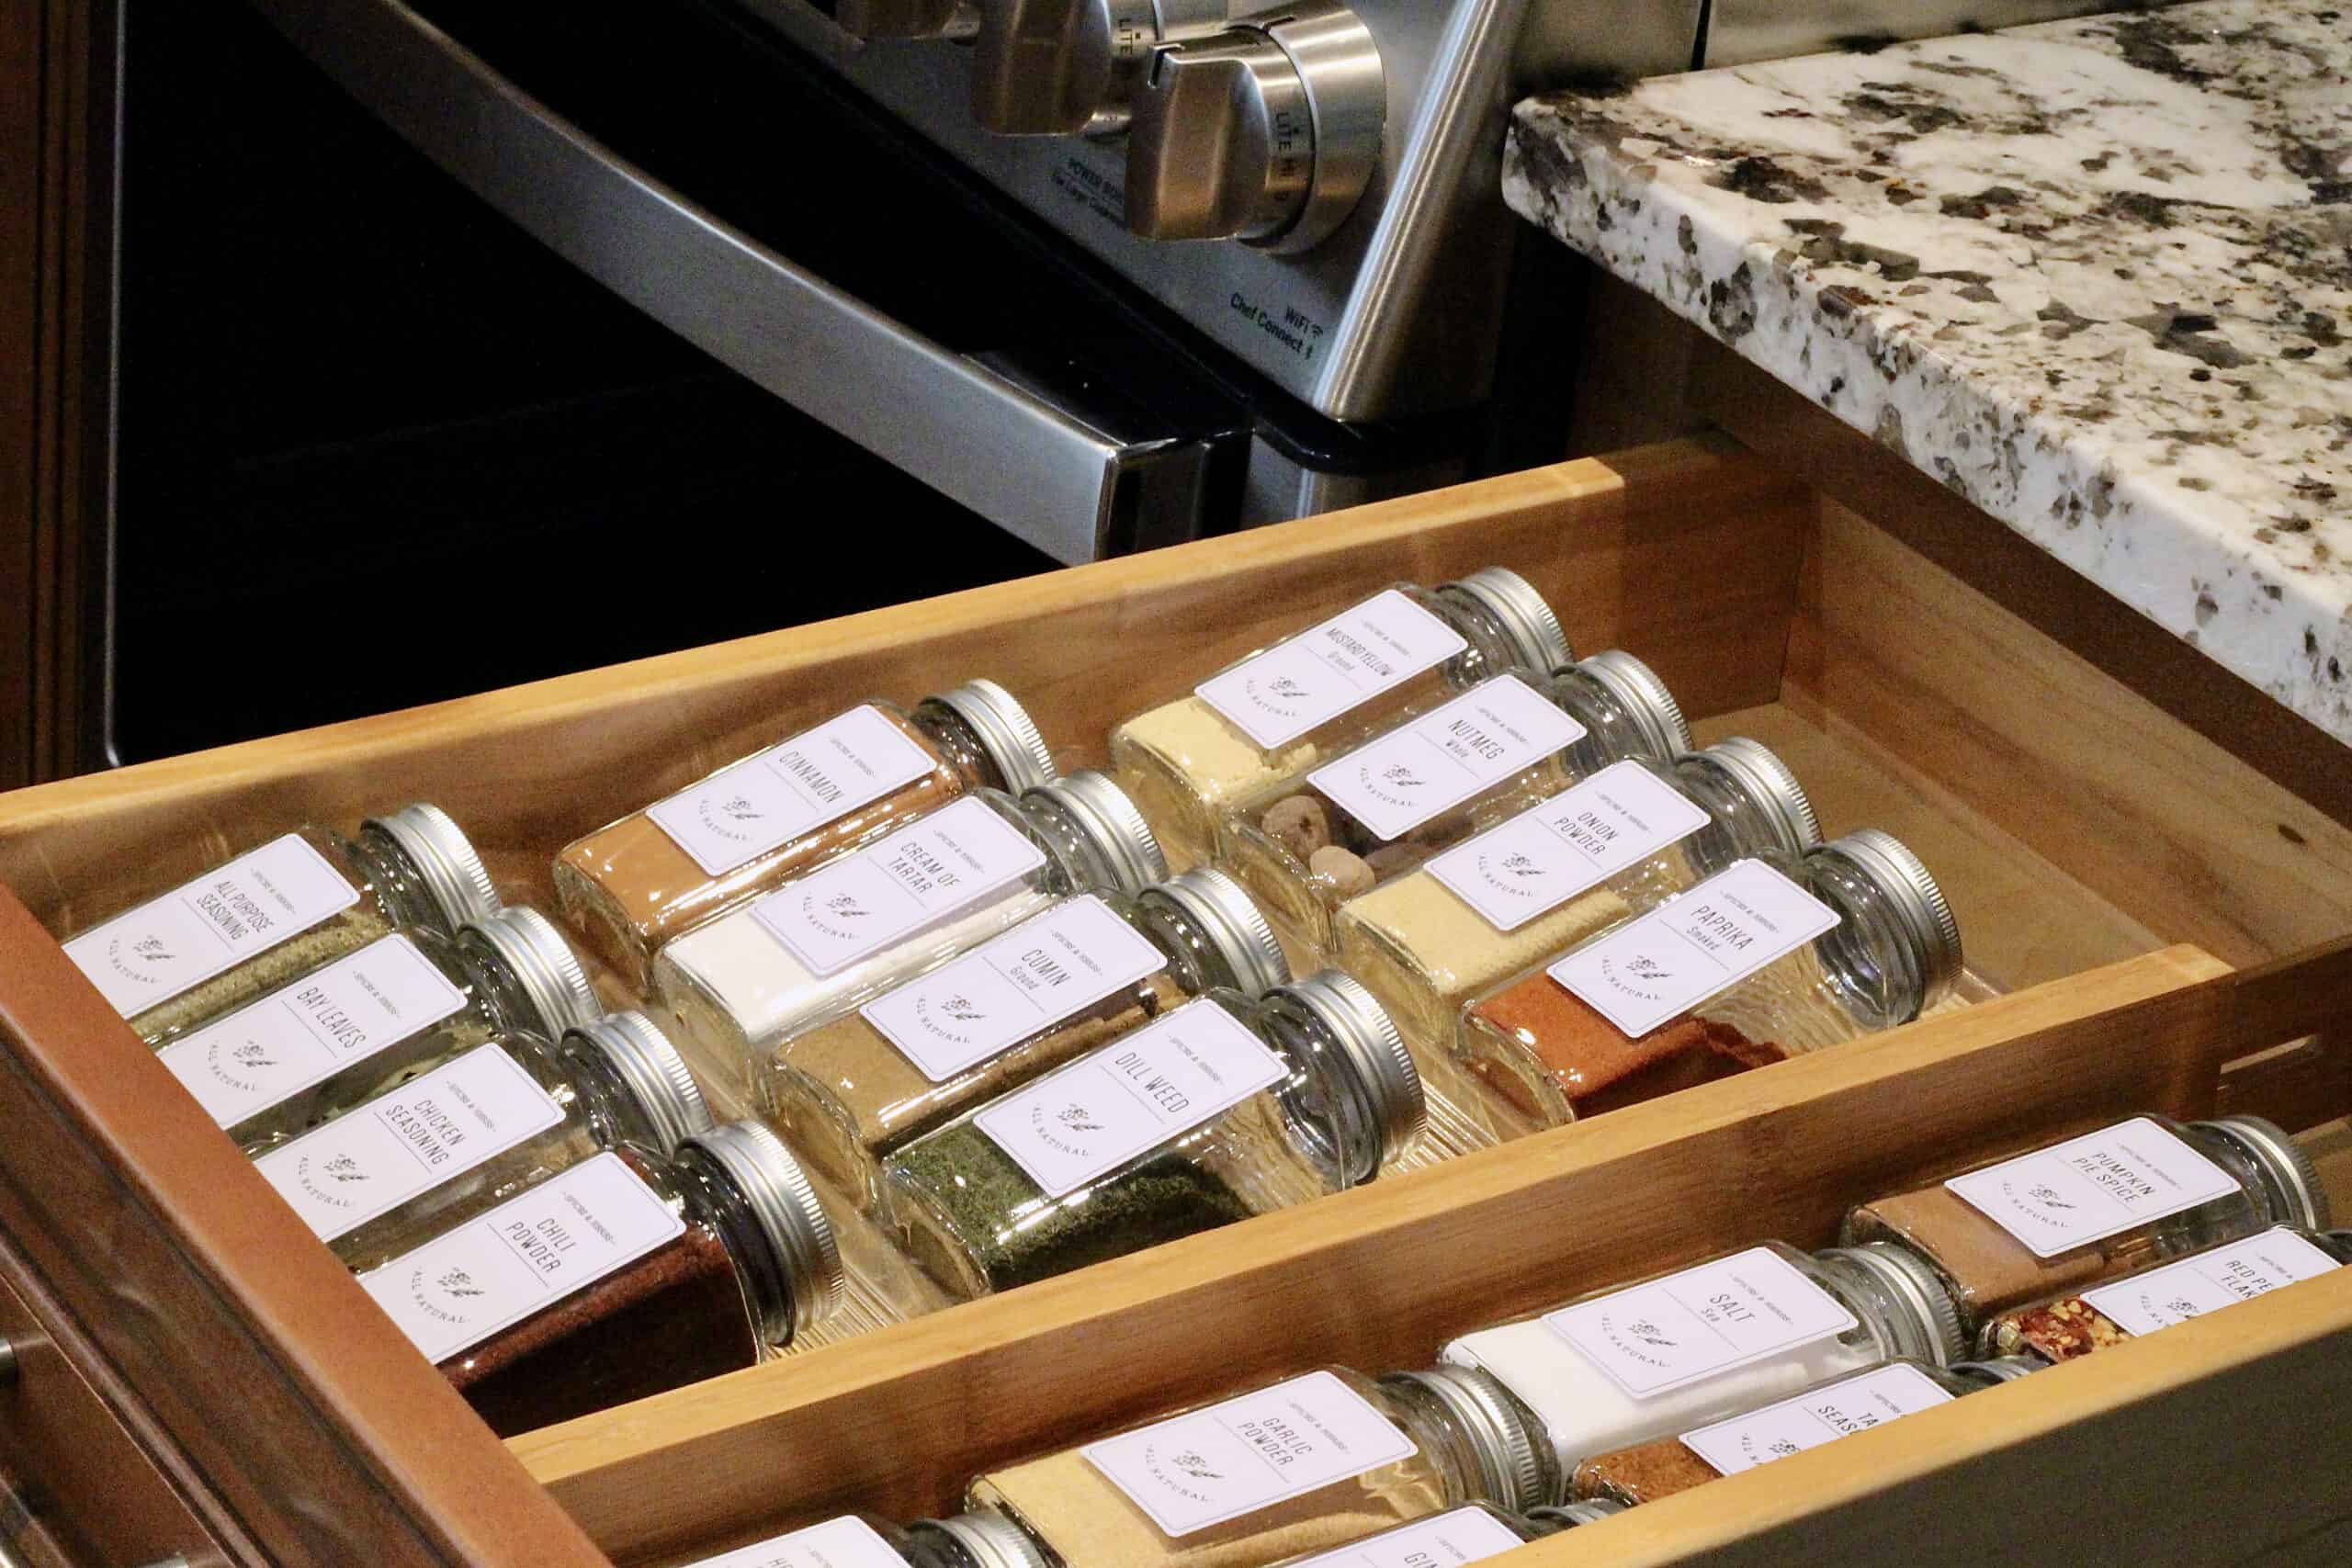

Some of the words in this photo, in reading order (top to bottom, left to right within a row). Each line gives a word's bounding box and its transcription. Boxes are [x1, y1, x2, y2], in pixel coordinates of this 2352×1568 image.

[1117, 17, 1134, 55] LITE
[1276, 111, 1292, 152] LITE
[1231, 292, 1259, 321] Chef
[1257, 310, 1303, 354] Connect
[1285, 305, 1310, 333] WiFi
[1448, 719, 1505, 759] NUTMEG
[779, 751, 845, 803] CINNAMON
[1554, 817, 1606, 855] POWDER
[1577, 811, 1617, 840] ONION
[888, 857, 933, 894] TARTAR
[900, 842, 944, 874] CREAM
[937, 874, 961, 888] OF
[197, 893, 248, 940] SEASONING
[228, 893, 274, 933] PURPOSE
[1690, 905, 1753, 950] PAPRIKA
[1021, 949, 1071, 987] CUMIN
[297, 987, 332, 1010] BAY
[315, 1007, 366, 1048] LEAVES
[1114, 1052, 1153, 1080] DILL
[1145, 1076, 1189, 1112] WEED
[386, 1104, 449, 1165] SEASONING
[413, 1100, 465, 1146] CHICKEN
[2072, 1157, 2100, 1173] PIE
[2095, 1174, 2143, 1202] SPICE
[2091, 1153, 2155, 1195] PUMPKIN
[504, 1222, 560, 1272] POWDER
[537, 1218, 576, 1252] CHILI
[2221, 1275, 2258, 1298] FLAK
[2224, 1260, 2256, 1278] RED
[2250, 1278, 2273, 1291] PE
[1710, 1294, 1756, 1323] SALT
[1261, 1417, 1313, 1455] GARLIC
[1818, 1405, 1858, 1435] SEAS
[1237, 1422, 1295, 1466] POWDER
